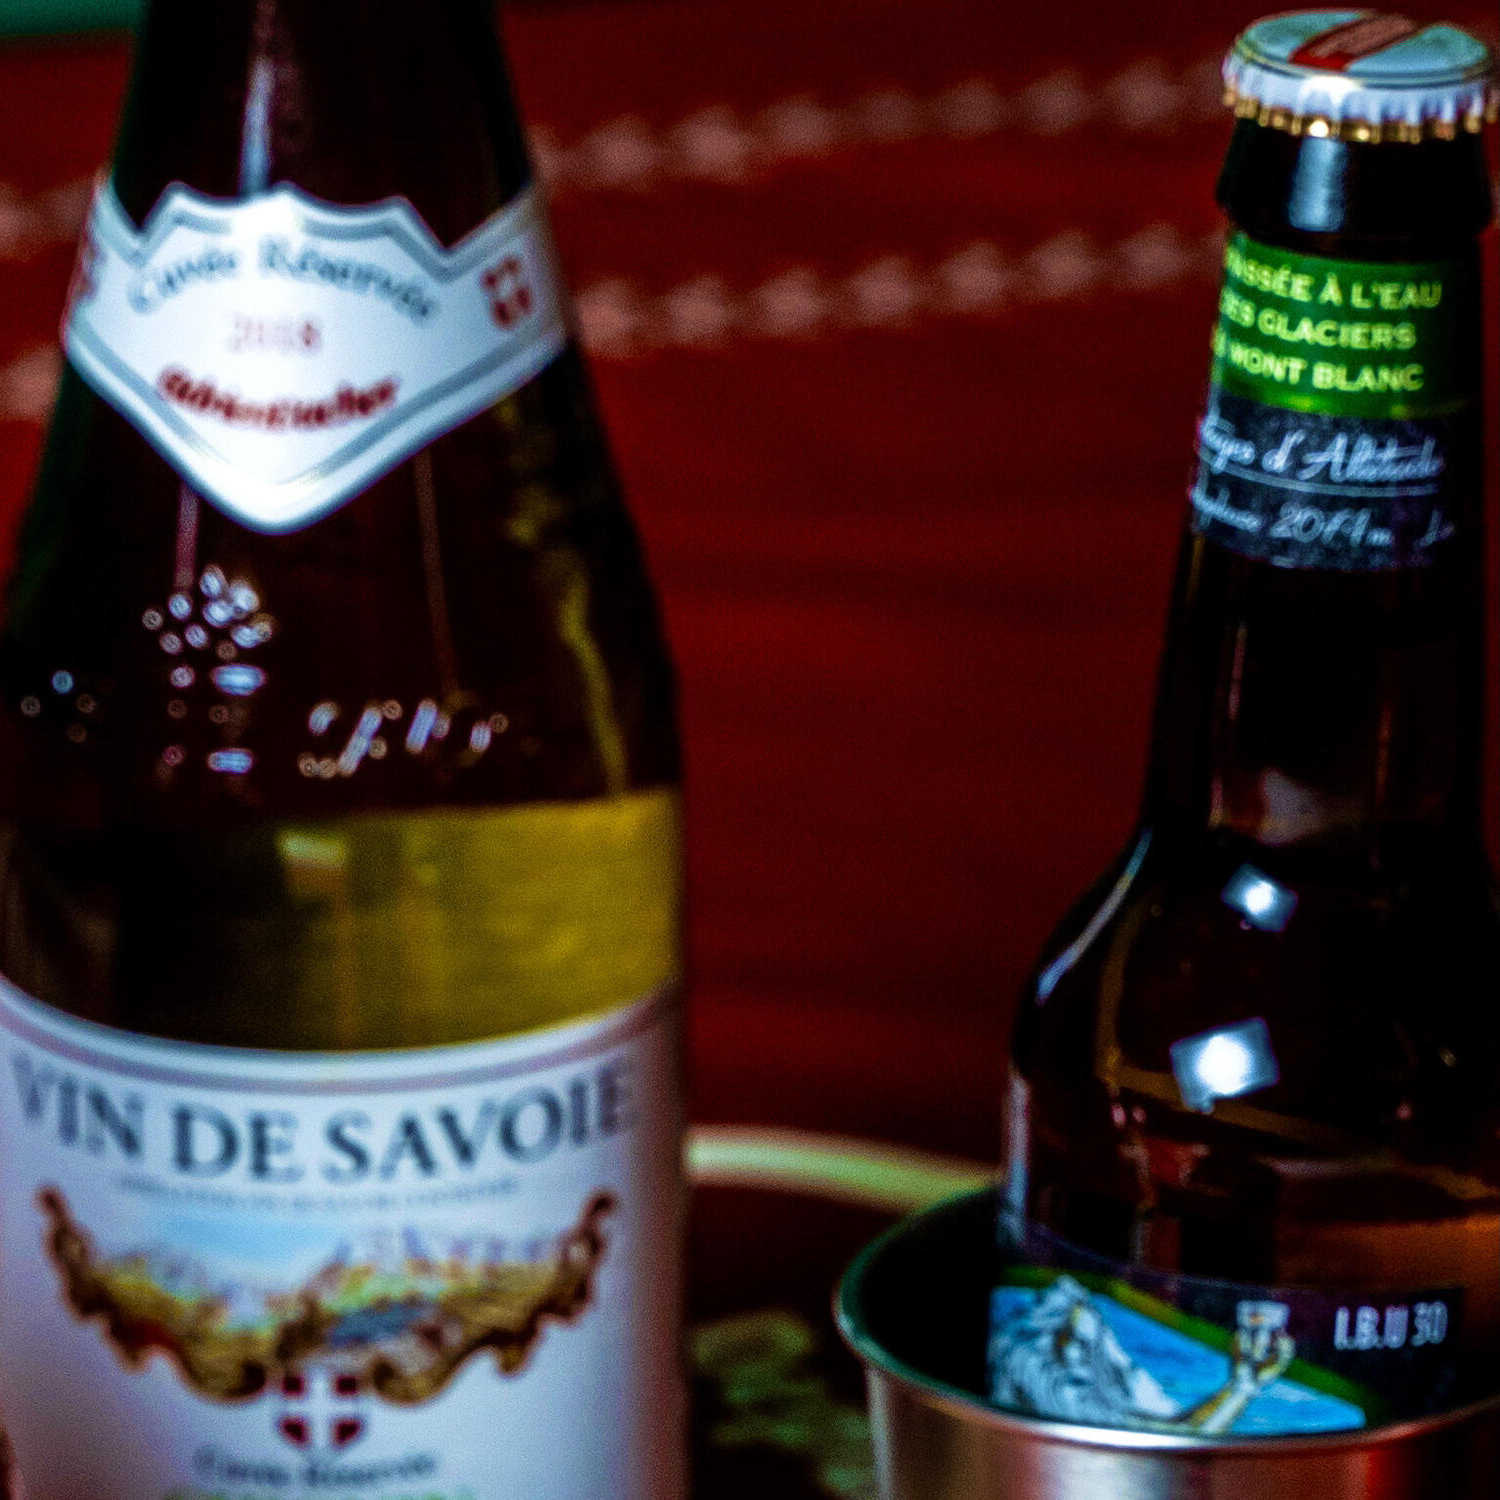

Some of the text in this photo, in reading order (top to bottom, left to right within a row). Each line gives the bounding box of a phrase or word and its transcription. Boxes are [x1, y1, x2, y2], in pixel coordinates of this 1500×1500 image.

[1318, 271, 1343, 308] À
[1351, 280, 1443, 310] L'EAU
[1257, 307, 1418, 350] GLACIERS
[1311, 360, 1425, 393] BLANC
[8, 1050, 637, 1184] VIN DE SAVOIE
